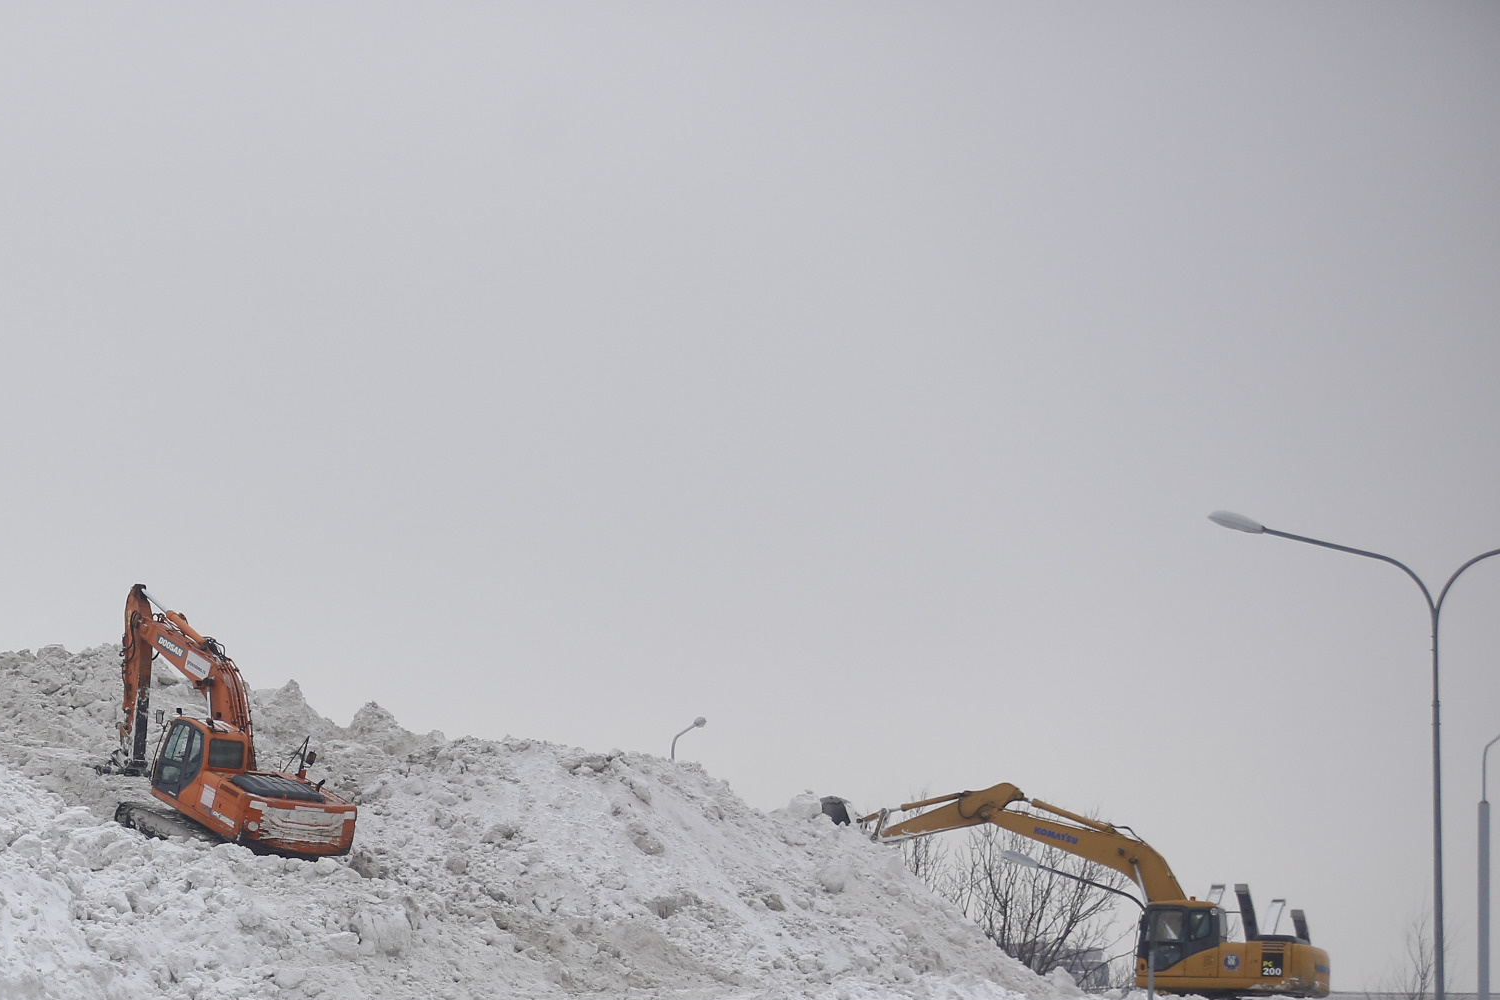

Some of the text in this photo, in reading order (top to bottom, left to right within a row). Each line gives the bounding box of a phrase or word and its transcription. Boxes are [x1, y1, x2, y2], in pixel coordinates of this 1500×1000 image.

[157, 636, 184, 657] DOOSAN
[1033, 827, 1079, 845] KOMATSU
[1262, 967, 1282, 976] 200
